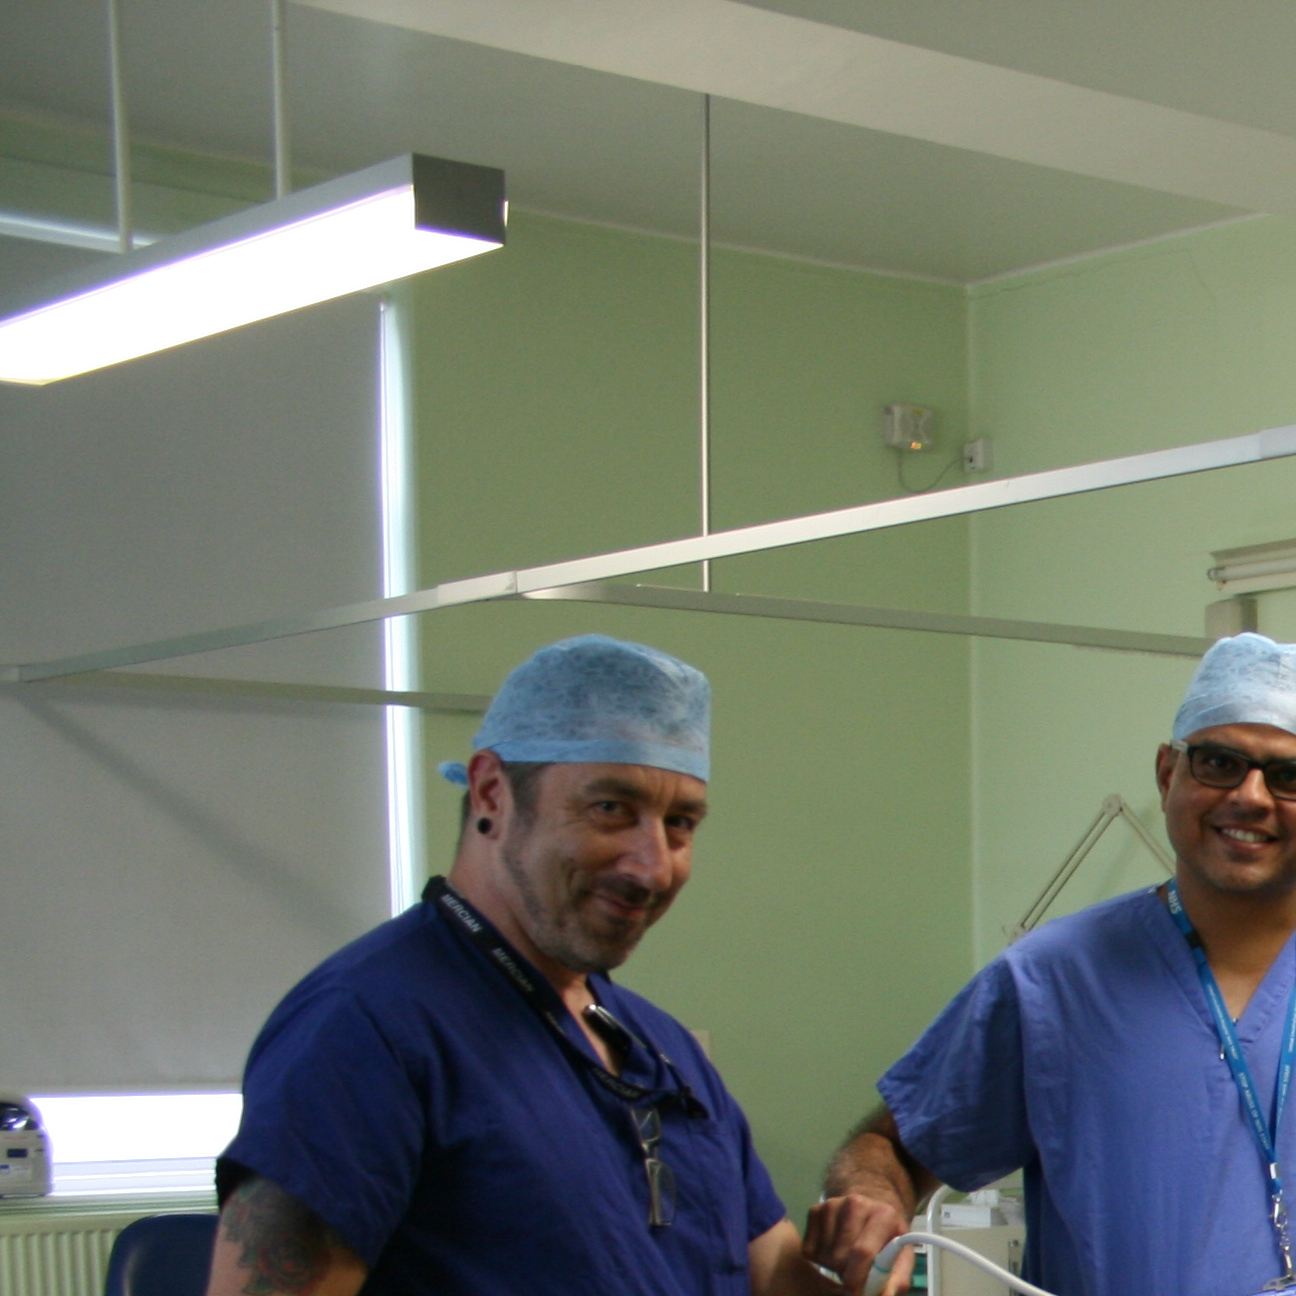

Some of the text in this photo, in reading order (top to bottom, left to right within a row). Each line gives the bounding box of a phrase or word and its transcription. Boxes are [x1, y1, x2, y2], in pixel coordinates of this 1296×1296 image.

[440, 894, 483, 932] MERCIAN
[1168, 890, 1182, 914] NHS
[492, 947, 534, 992] MERCIAN
